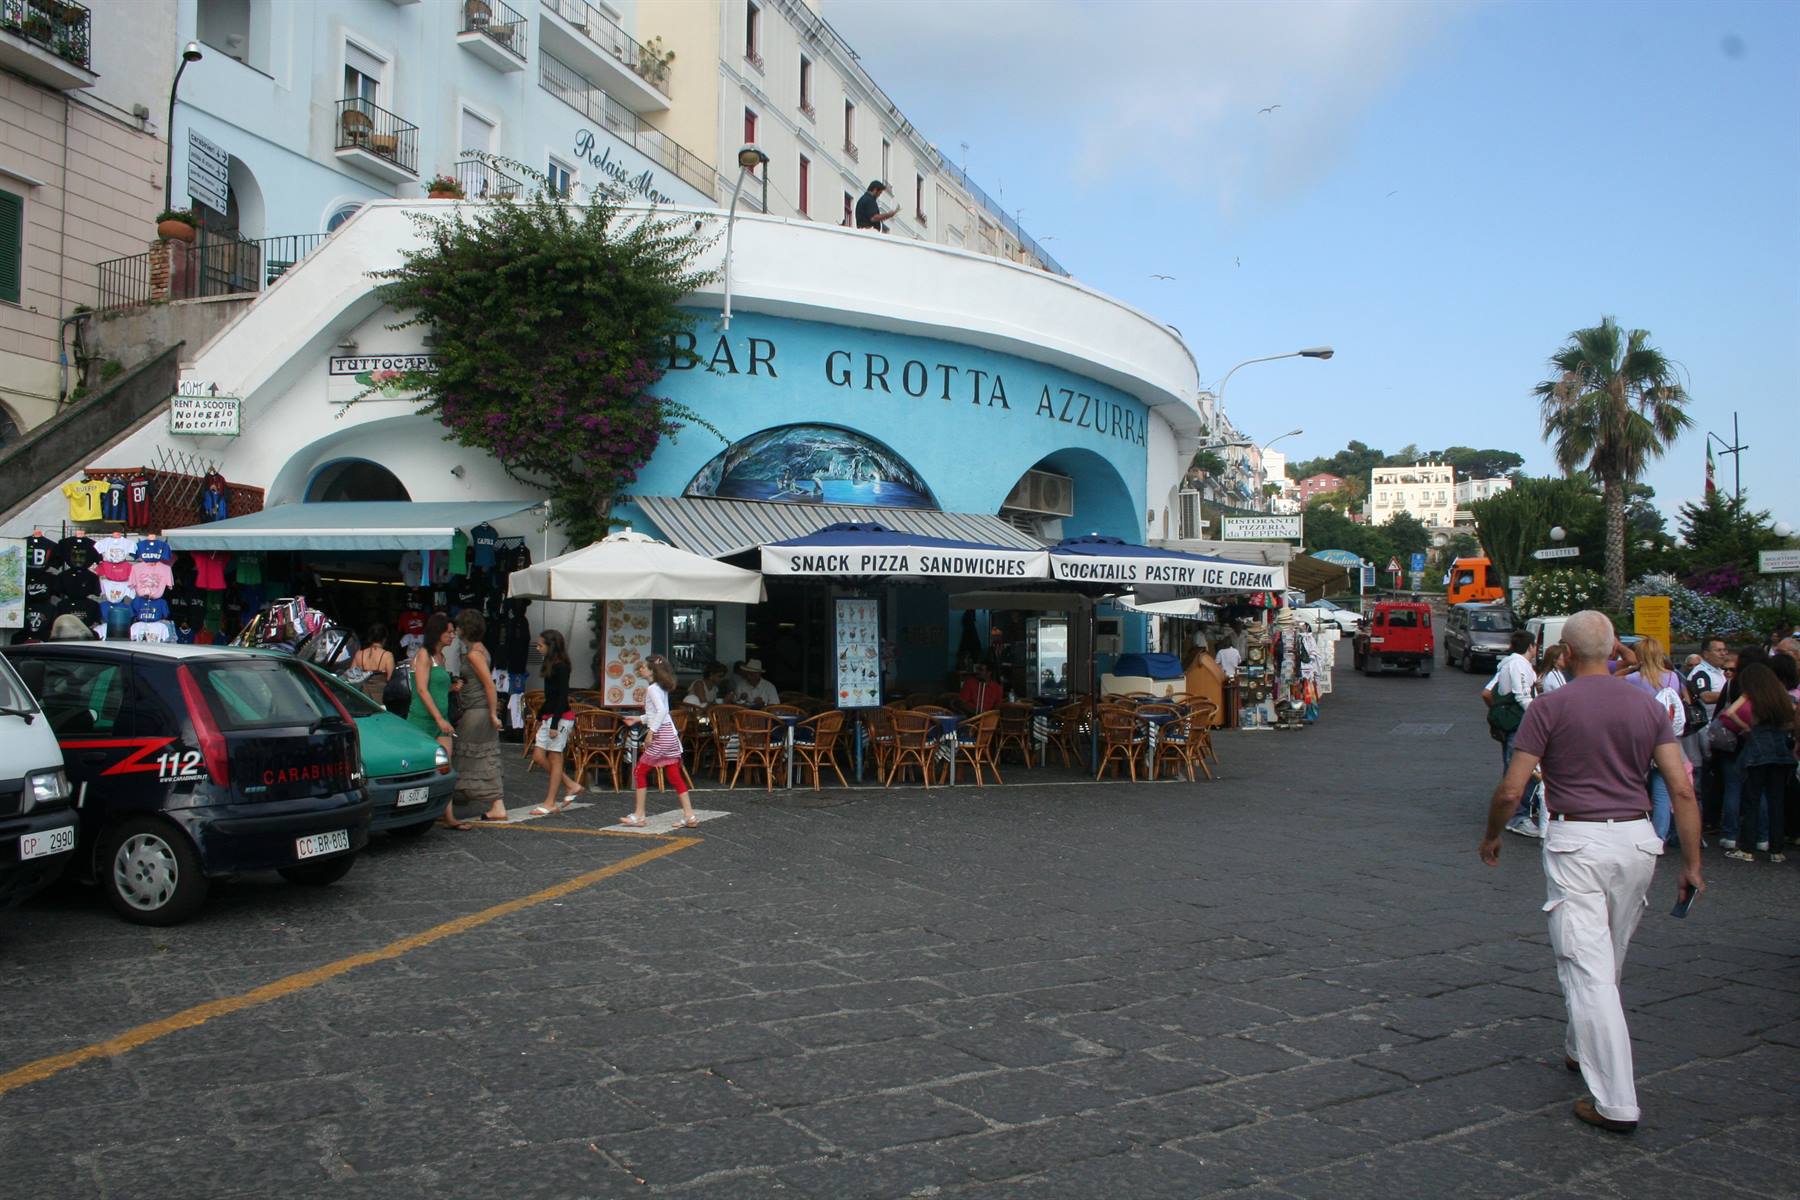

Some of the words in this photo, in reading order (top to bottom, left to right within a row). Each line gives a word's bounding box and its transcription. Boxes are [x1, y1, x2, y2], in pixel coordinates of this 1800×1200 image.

[573, 128, 627, 183] Relais
[666, 331, 778, 378] BAR
[825, 350, 1011, 409] GROTTA
[1035, 383, 1146, 447] AZZURRA
[174, 400, 193, 408] RENT
[195, 400, 201, 408] A
[203, 401, 237, 410] SCOOTER
[175, 409, 233, 419] Noleggio
[174, 417, 233, 429] Motorini
[112, 489, 120, 507] 8
[1243, 529, 1298, 537] PEPPINO
[790, 555, 850, 572] SNACK
[861, 555, 909, 572] PIZZA
[919, 556, 1026, 576] SANDWICHES
[1060, 562, 1137, 581] COCKTAILS
[1145, 565, 1196, 583] PASTRY
[1202, 568, 1223, 585] ICE
[1230, 571, 1273, 588] CREAM
[157, 750, 201, 777] 112
[23, 838, 37, 856] CP
[50, 830, 73, 850] 2990
[299, 839, 314, 856] CC
